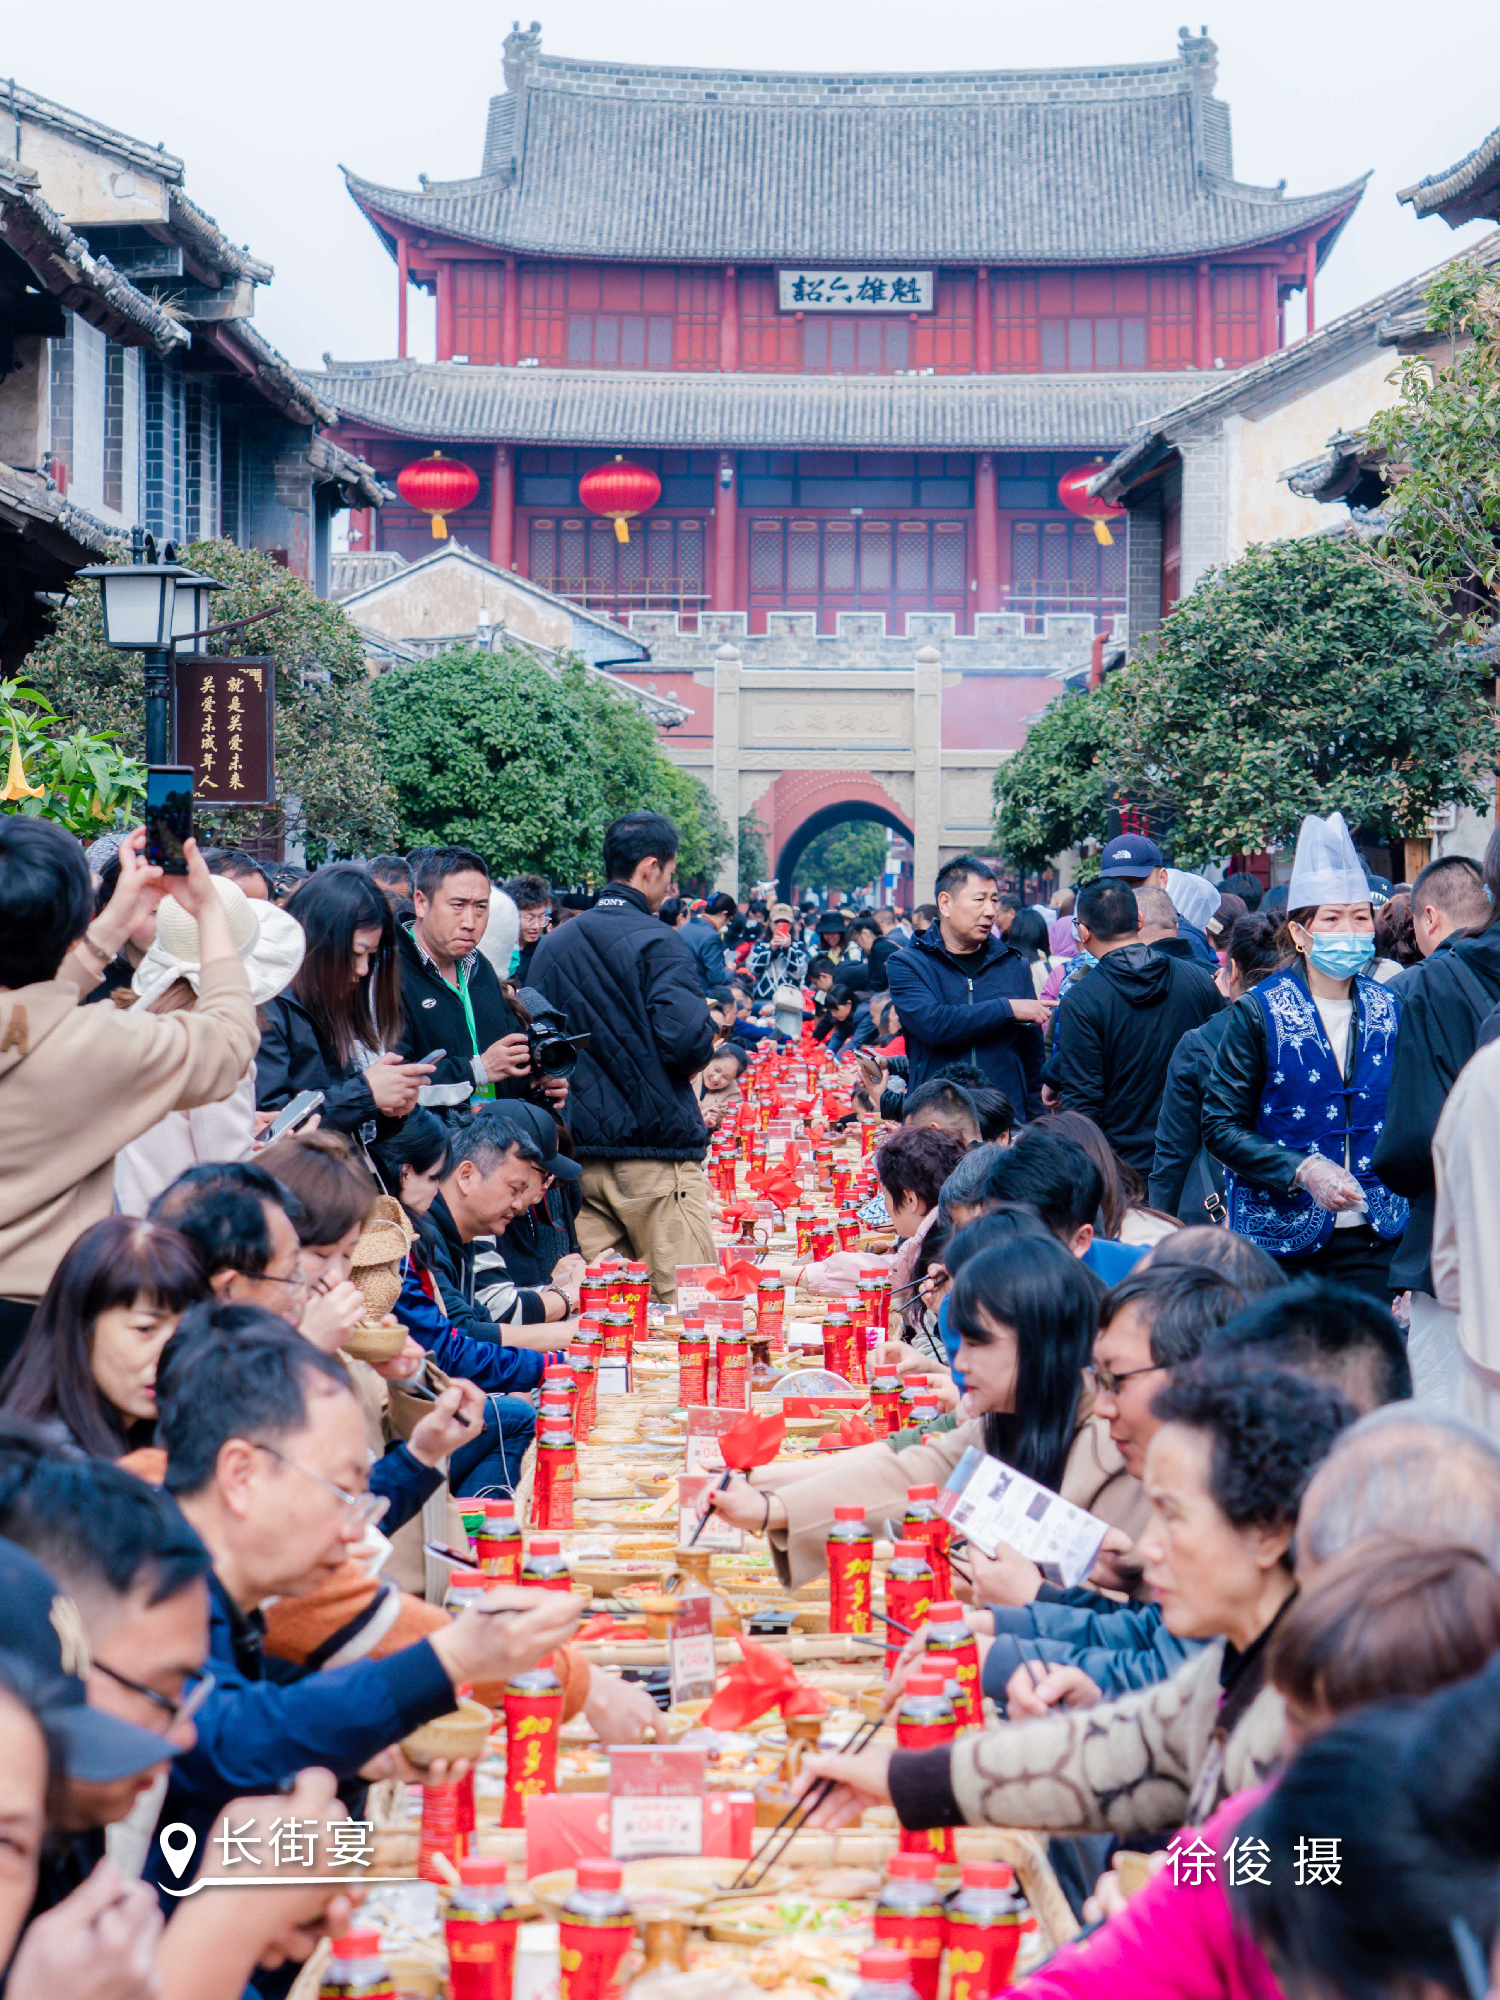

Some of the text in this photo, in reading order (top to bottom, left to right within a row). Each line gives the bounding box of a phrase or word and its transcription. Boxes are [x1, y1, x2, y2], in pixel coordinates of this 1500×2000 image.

[198, 675, 219, 789] 关爱未成年人
[226, 676, 246, 791] 就是关爱未来
[597, 898, 627, 907] SONY
[0, 1004, 30, 1055] A
[638, 1814, 680, 1834] 047
